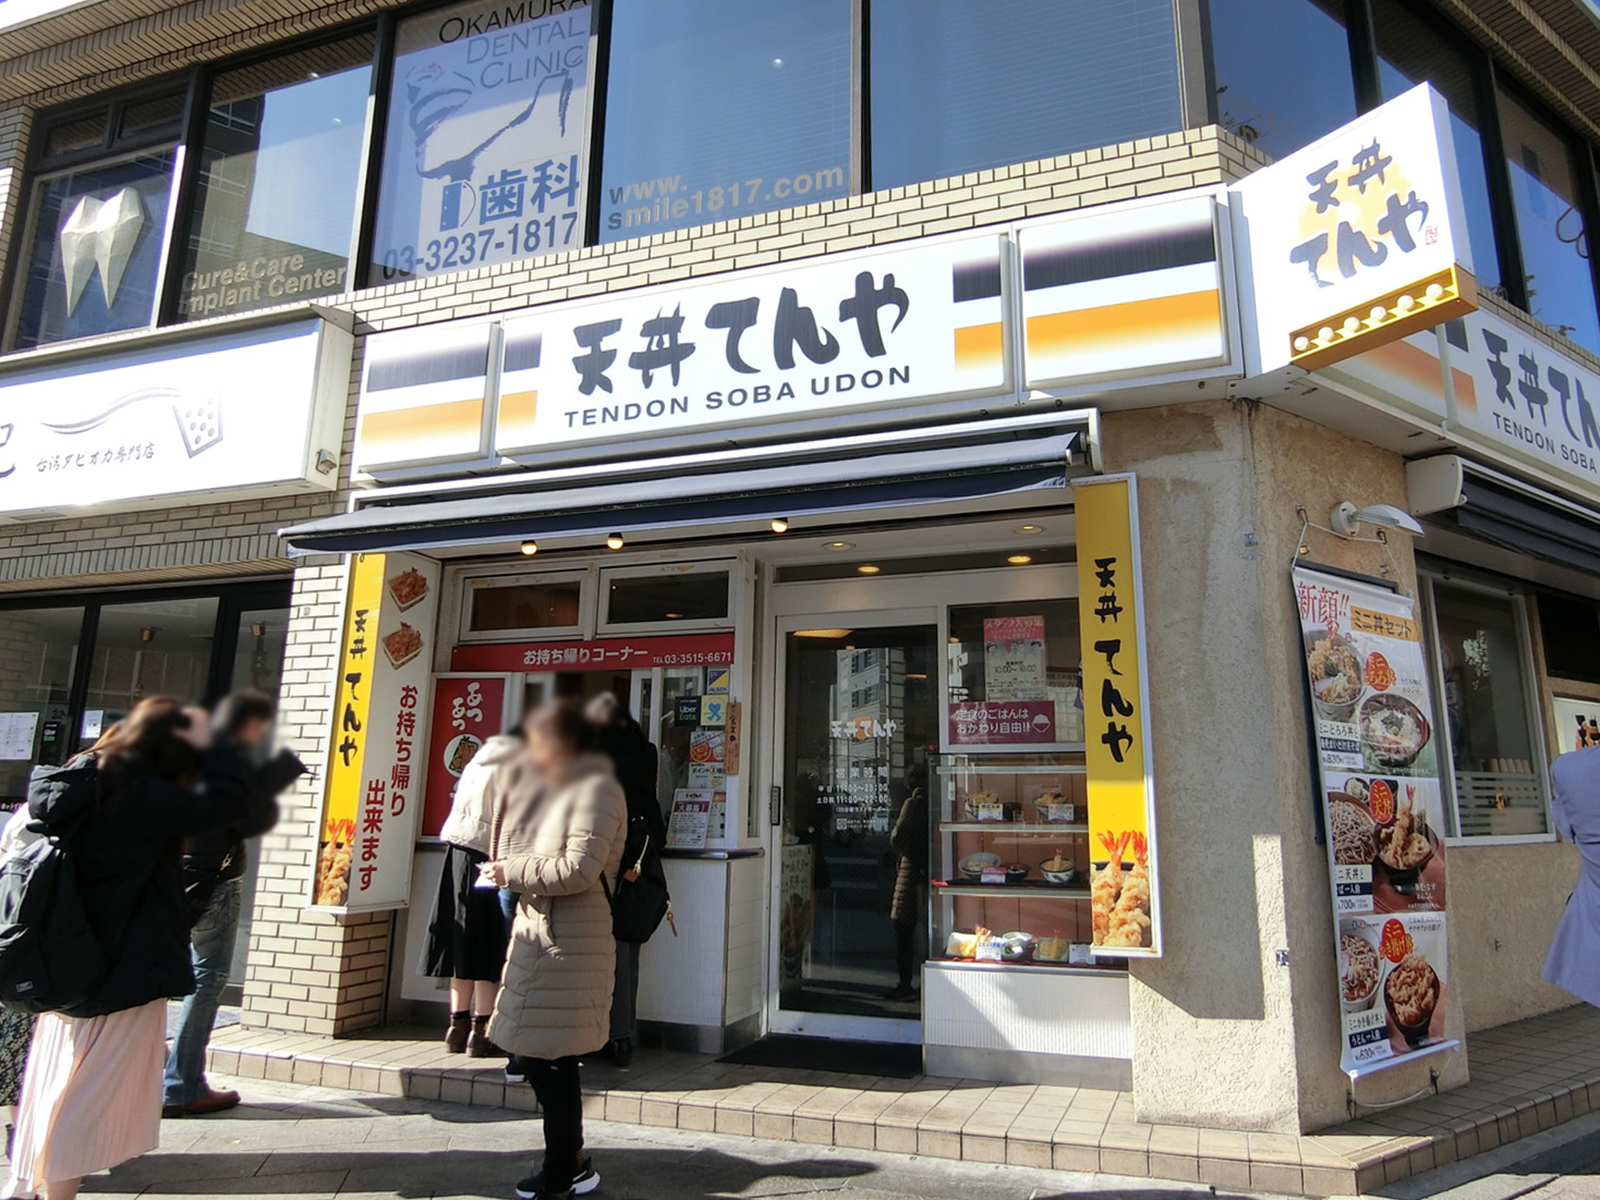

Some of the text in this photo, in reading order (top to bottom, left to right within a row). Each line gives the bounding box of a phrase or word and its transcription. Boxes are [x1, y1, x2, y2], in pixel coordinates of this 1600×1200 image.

[467, 17, 586, 64] DENTAL
[480, 45, 584, 89] CLINIC
[479, 154, 580, 225] 歯科
[607, 167, 843, 230] smile1817.com
[609, 175, 687, 205] www.
[1306, 136, 1392, 214] 天丼
[383, 212, 578, 280] 03-3237-1817
[1290, 190, 1429, 288] てんや
[183, 254, 304, 291] Cure&Care
[268, 267, 346, 297] Center
[572, 271, 910, 396] 天丼てんや
[564, 366, 911, 427] TENDON SOBA UDON
[1493, 412, 1598, 473] TENDON SOBA
[523, 646, 648, 665] お持ち帰りコーナー
[665, 652, 731, 664] 03-3515-6671
[1094, 557, 1134, 763] 天丼てんや
[339, 608, 369, 767] 天丼てんや
[391, 684, 418, 817] お持ち帰り
[831, 718, 897, 738] 天丼てんや
[956, 722, 1030, 734] おかわり自由!!
[359, 779, 386, 892] 出来ます
